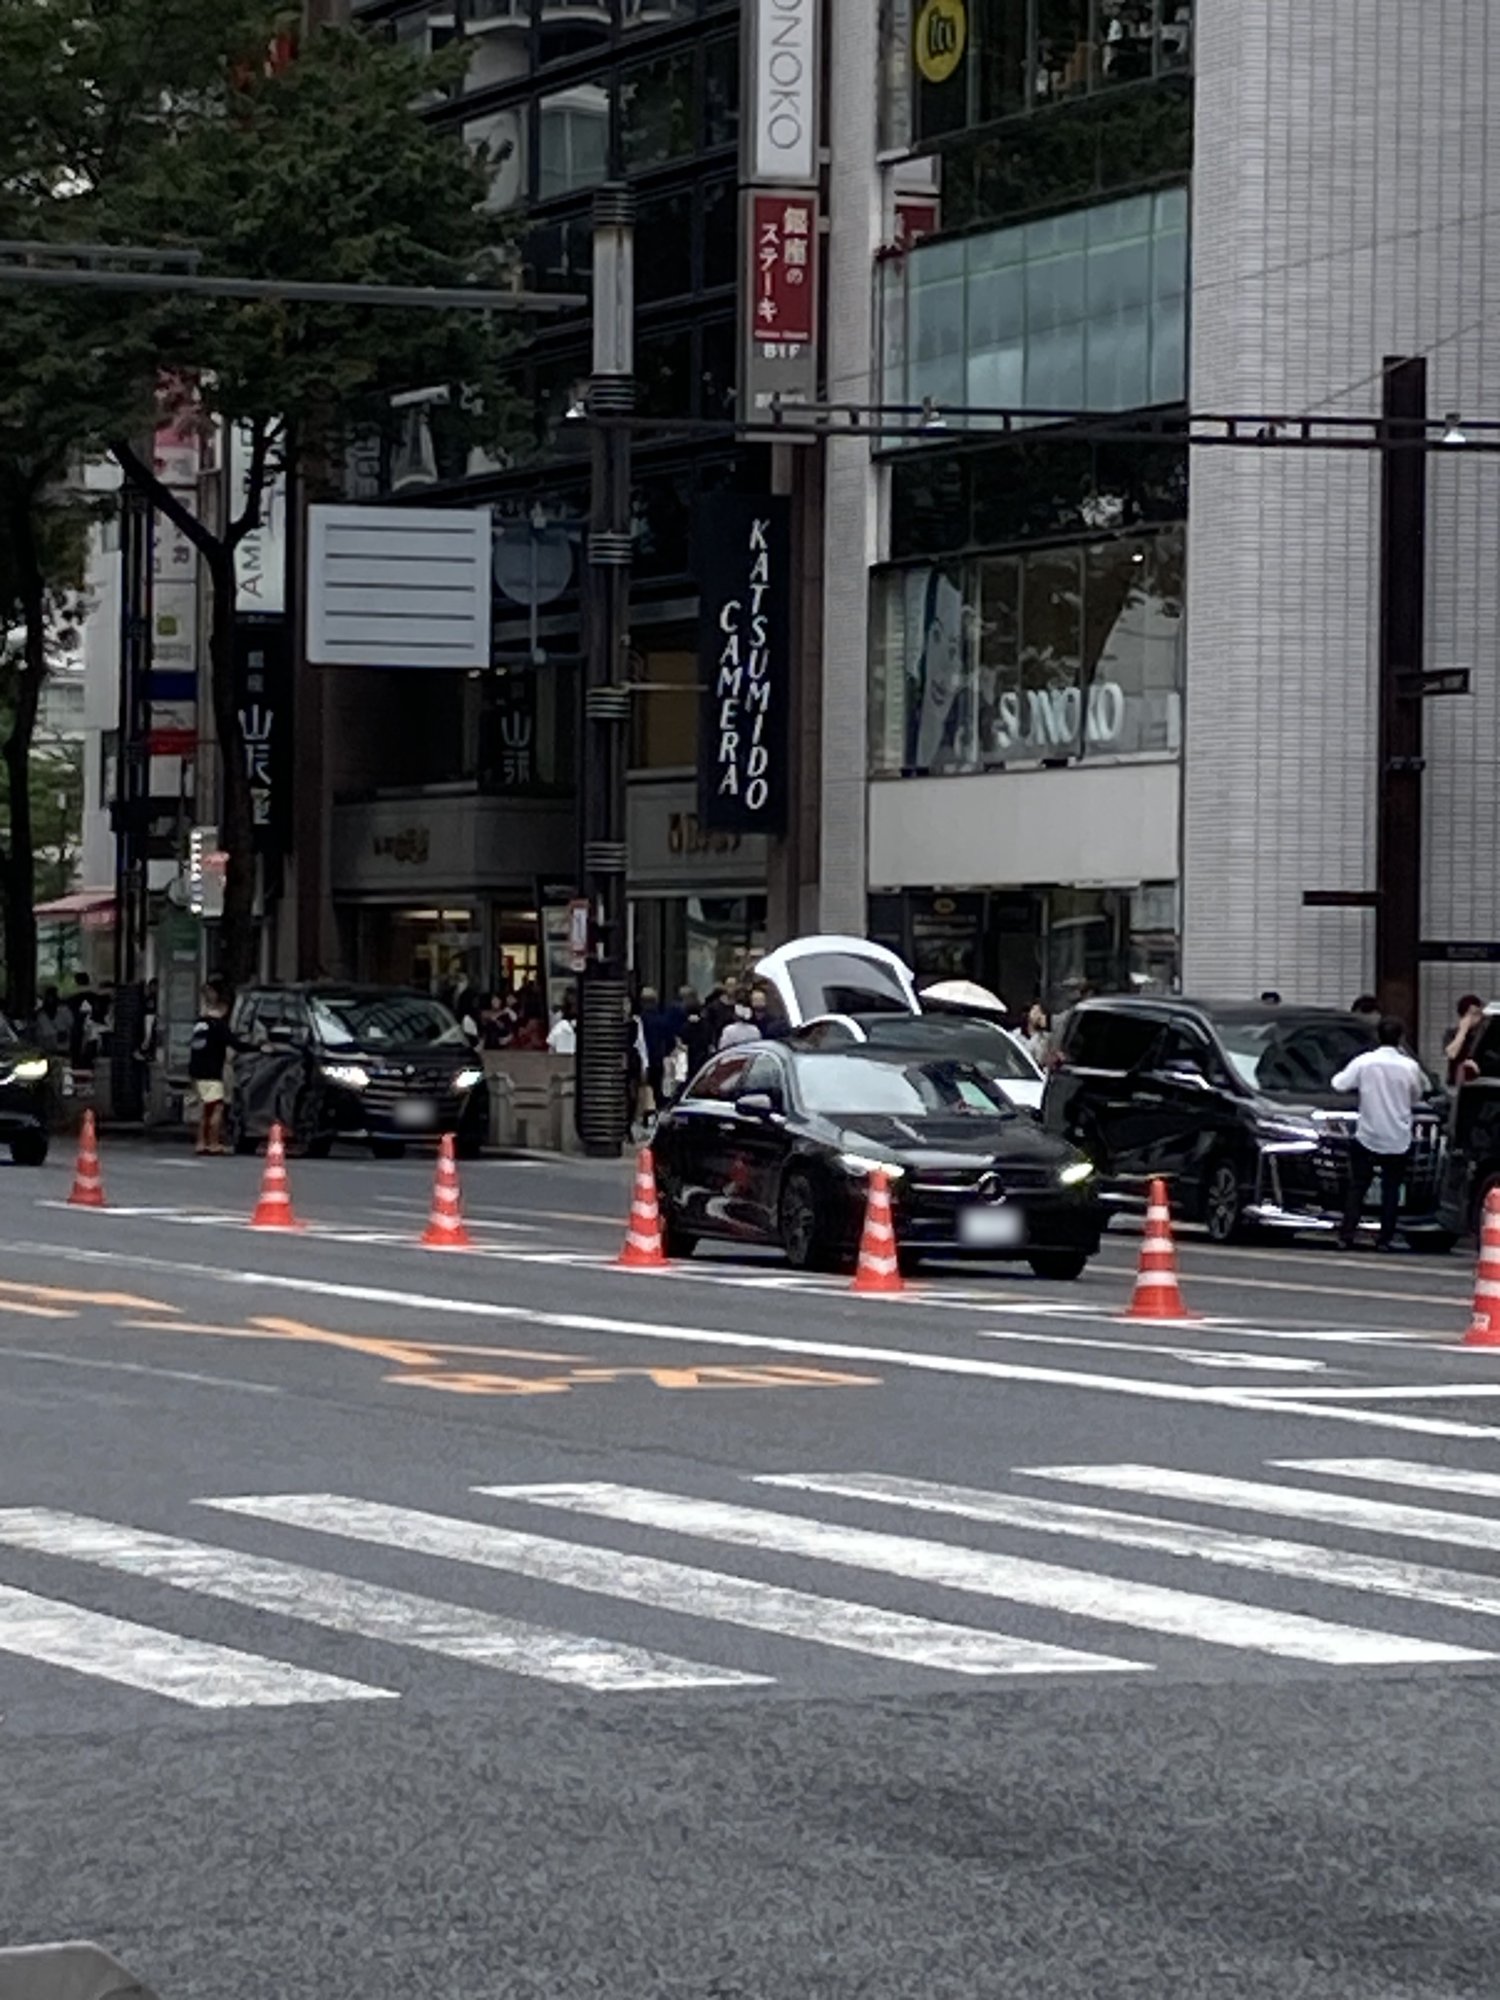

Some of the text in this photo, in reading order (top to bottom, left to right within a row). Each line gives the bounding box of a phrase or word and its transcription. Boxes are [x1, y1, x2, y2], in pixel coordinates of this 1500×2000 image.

[758, 222, 780, 324] ステーキ
[716, 600, 743, 795] CAMERA
[745, 517, 771, 810] KATSUMIDO
